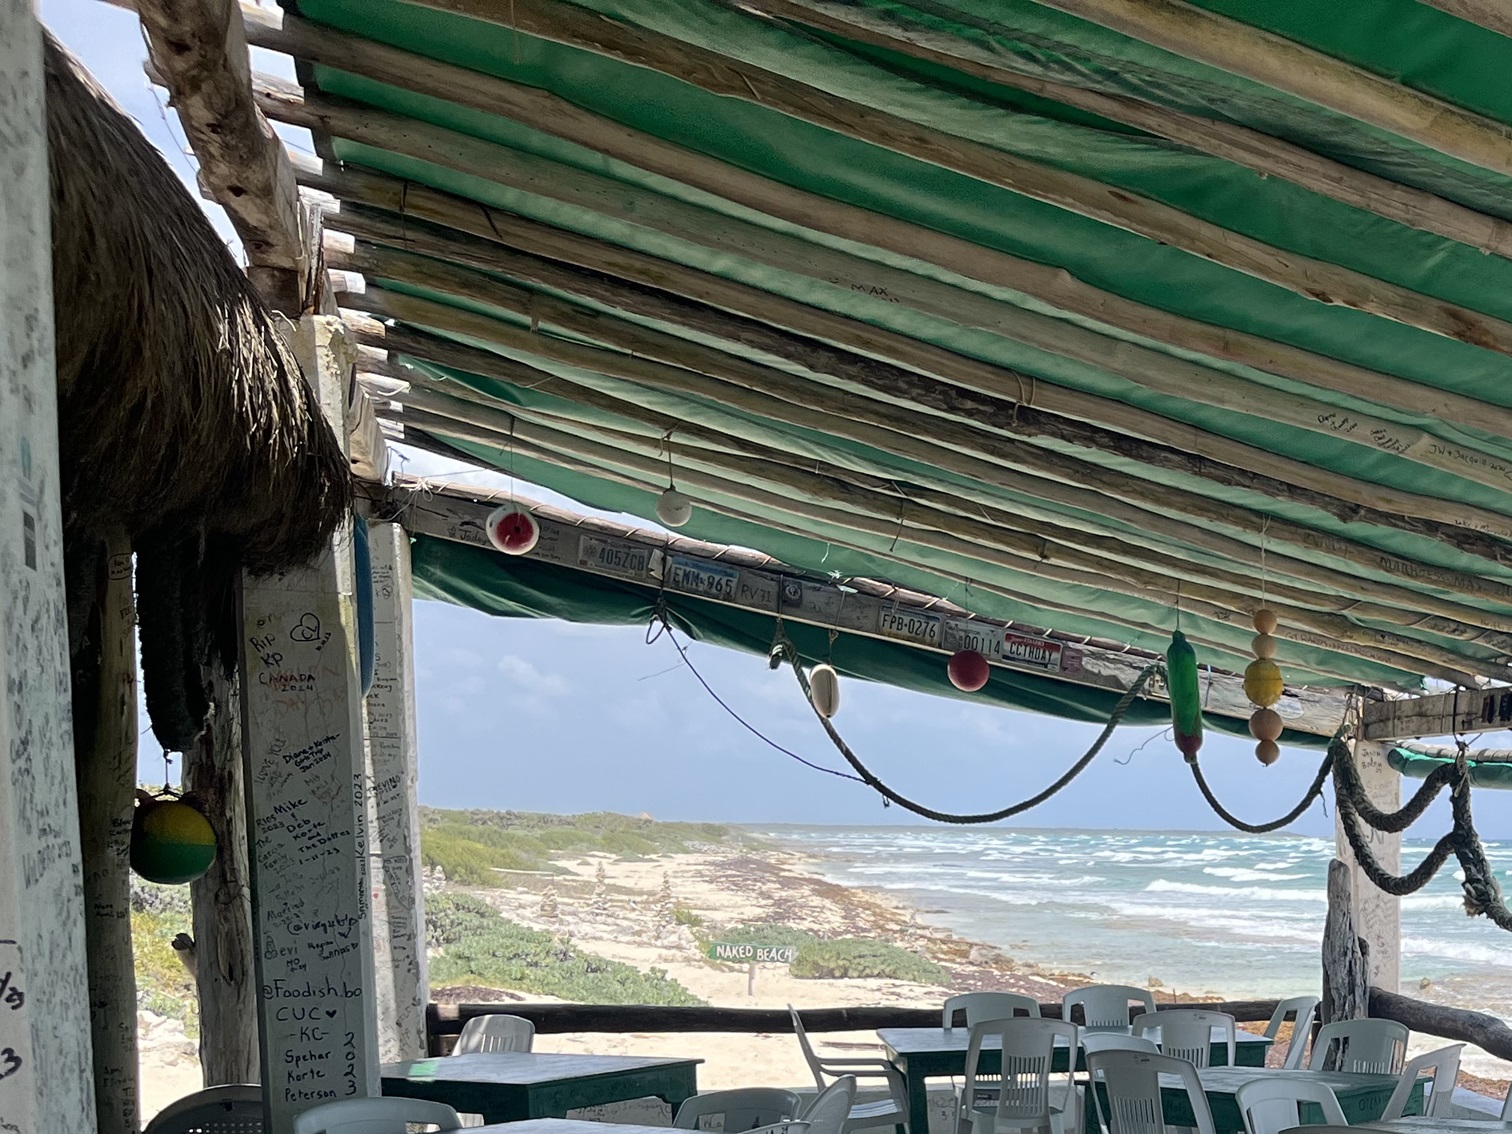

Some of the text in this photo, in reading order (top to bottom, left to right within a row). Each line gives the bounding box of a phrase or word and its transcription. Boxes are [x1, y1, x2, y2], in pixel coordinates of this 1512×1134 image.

[353, 773, 364, 808] 2023
[273, 799, 308, 815] Mike
[716, 944, 793, 962] NAKED BEACH
